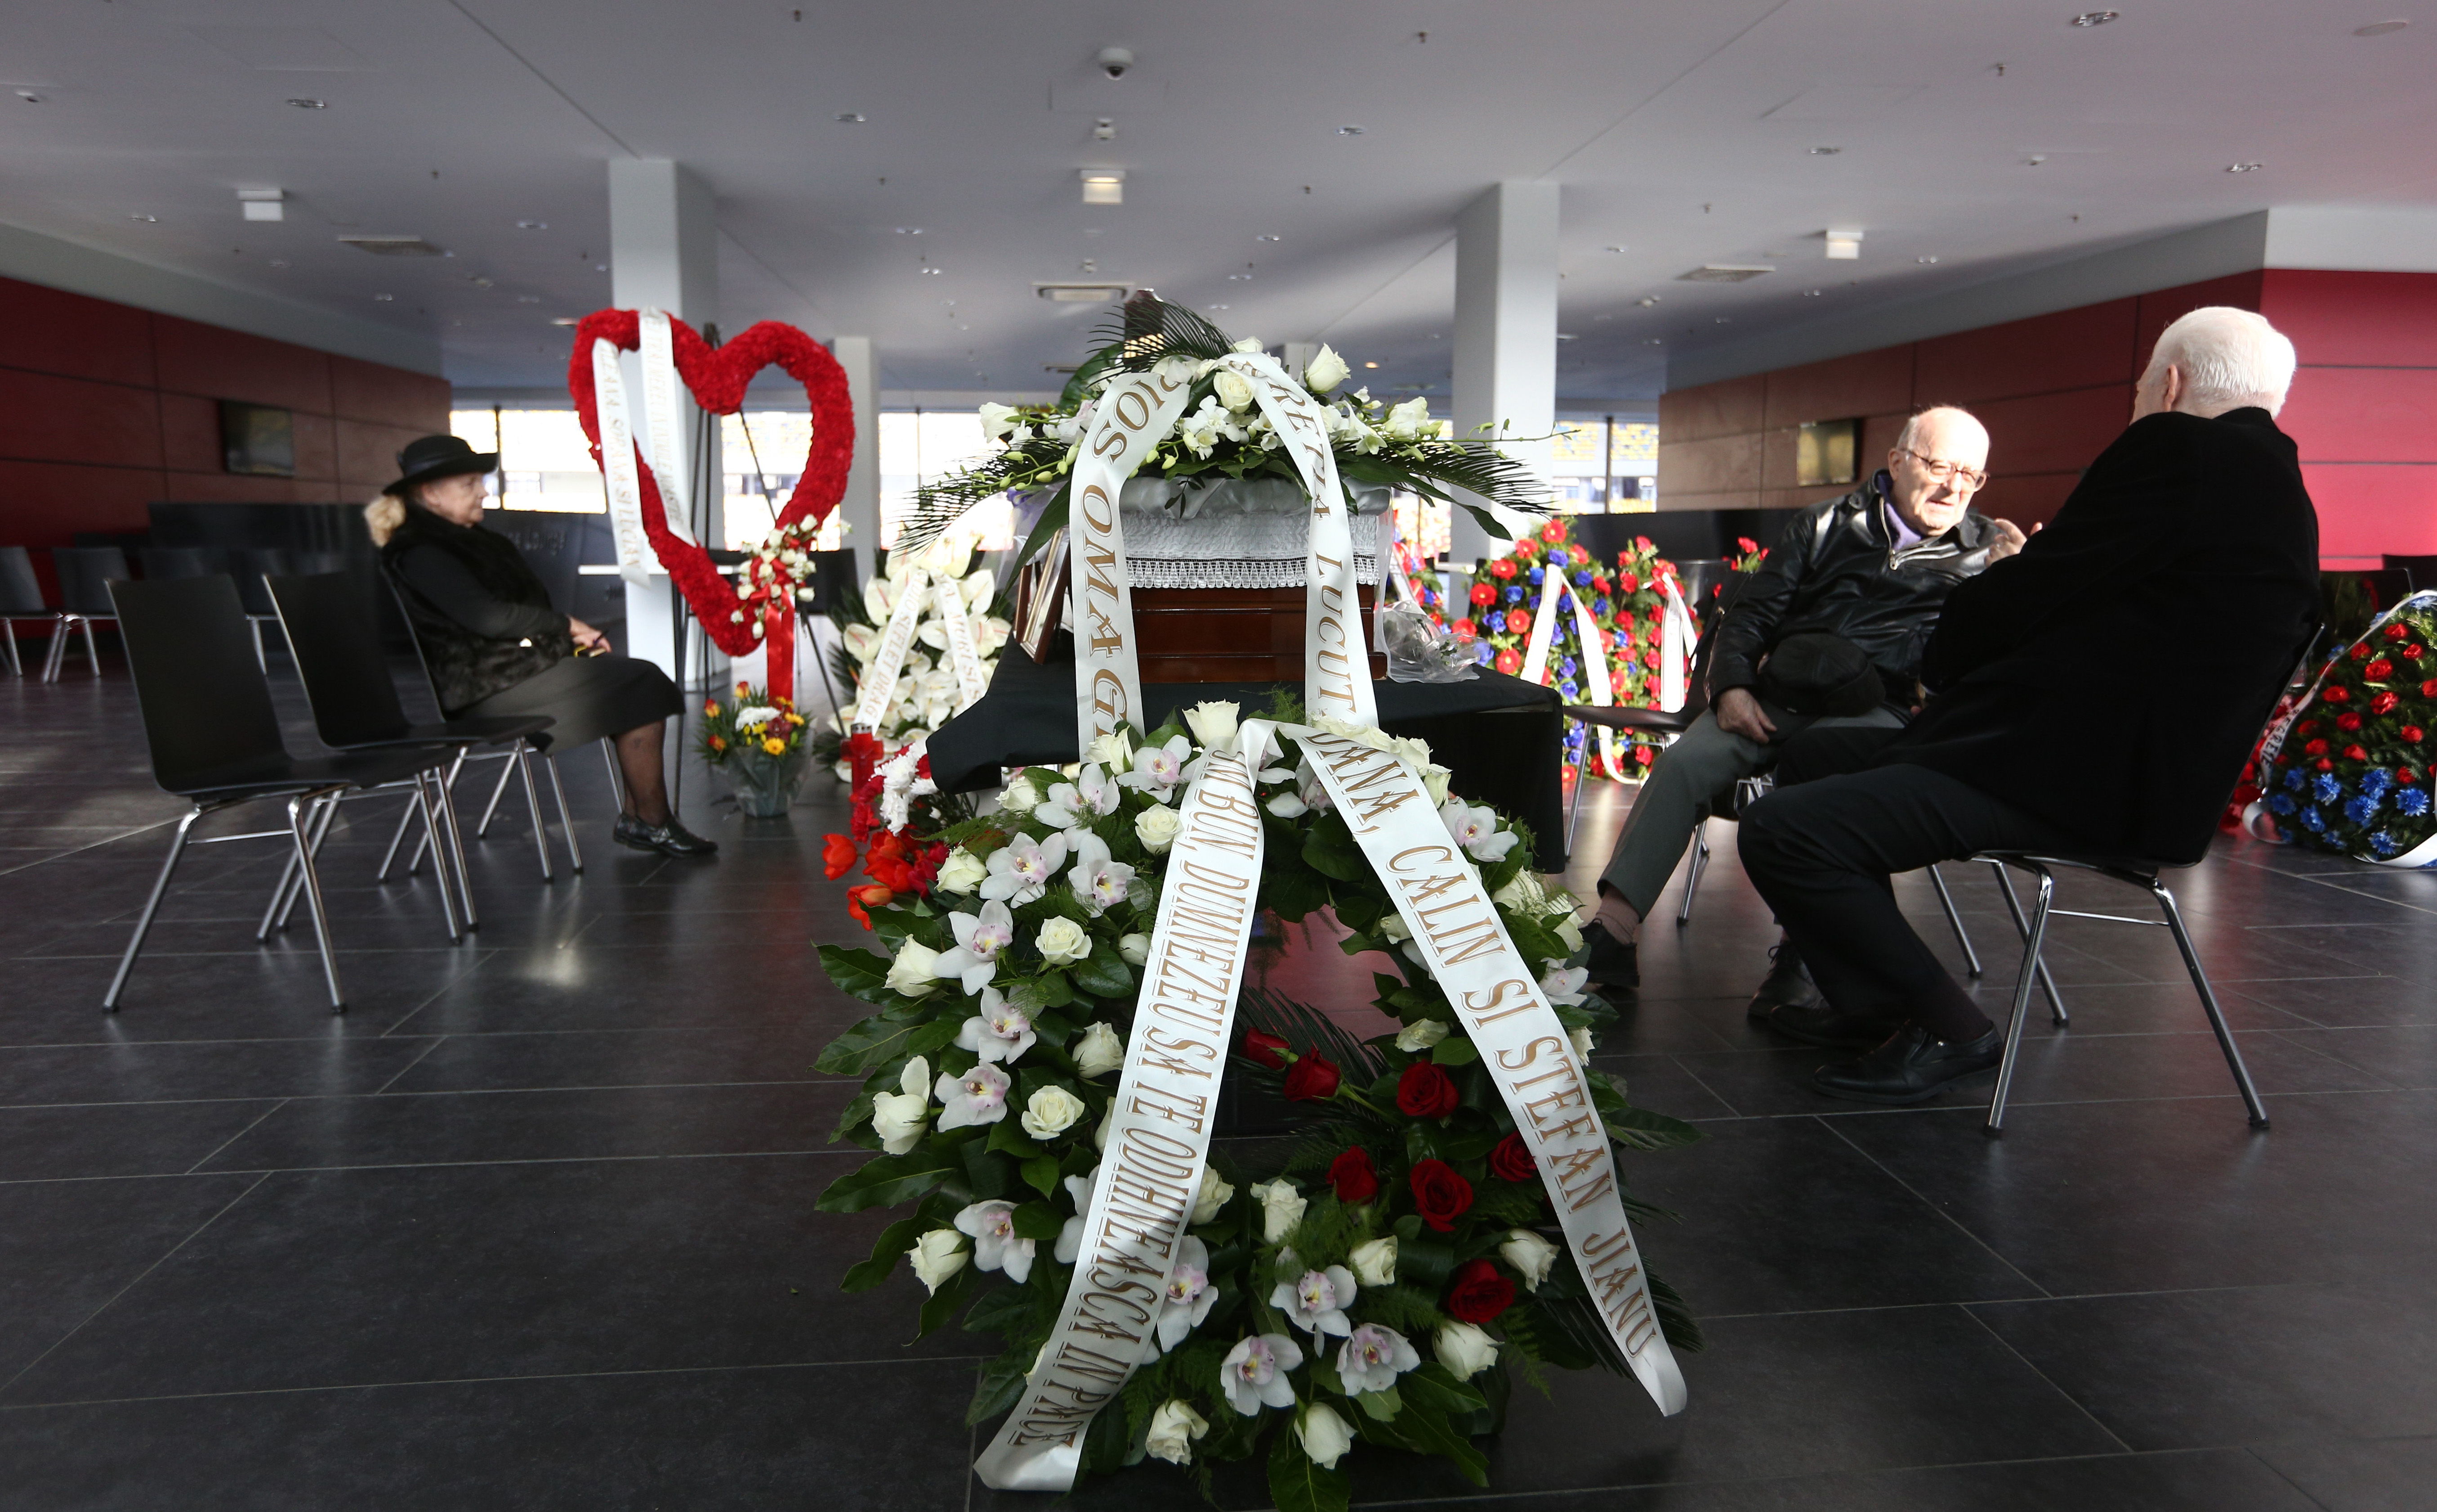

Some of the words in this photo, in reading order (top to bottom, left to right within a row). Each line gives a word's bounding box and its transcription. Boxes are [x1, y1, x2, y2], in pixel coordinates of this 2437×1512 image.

[883, 611, 911, 674] SUFLET
[1314, 551, 1357, 719] LUCUT
[1173, 788, 1259, 861] BUN,
[1386, 845, 1506, 969] CALIN
[1148, 860, 1250, 1038] DUMNEZEU
[1460, 978, 1540, 1031] SI
[1137, 1025, 1218, 1080] SA
[1127, 1080, 1208, 1136] TE
[1493, 1036, 1613, 1215] STEFAN
[1068, 1127, 1197, 1346] ODIHNEASCA
[1579, 1227, 1657, 1359] JIANU
[1053, 1342, 1131, 1386] IN
[1008, 1379, 1111, 1449] PACE
